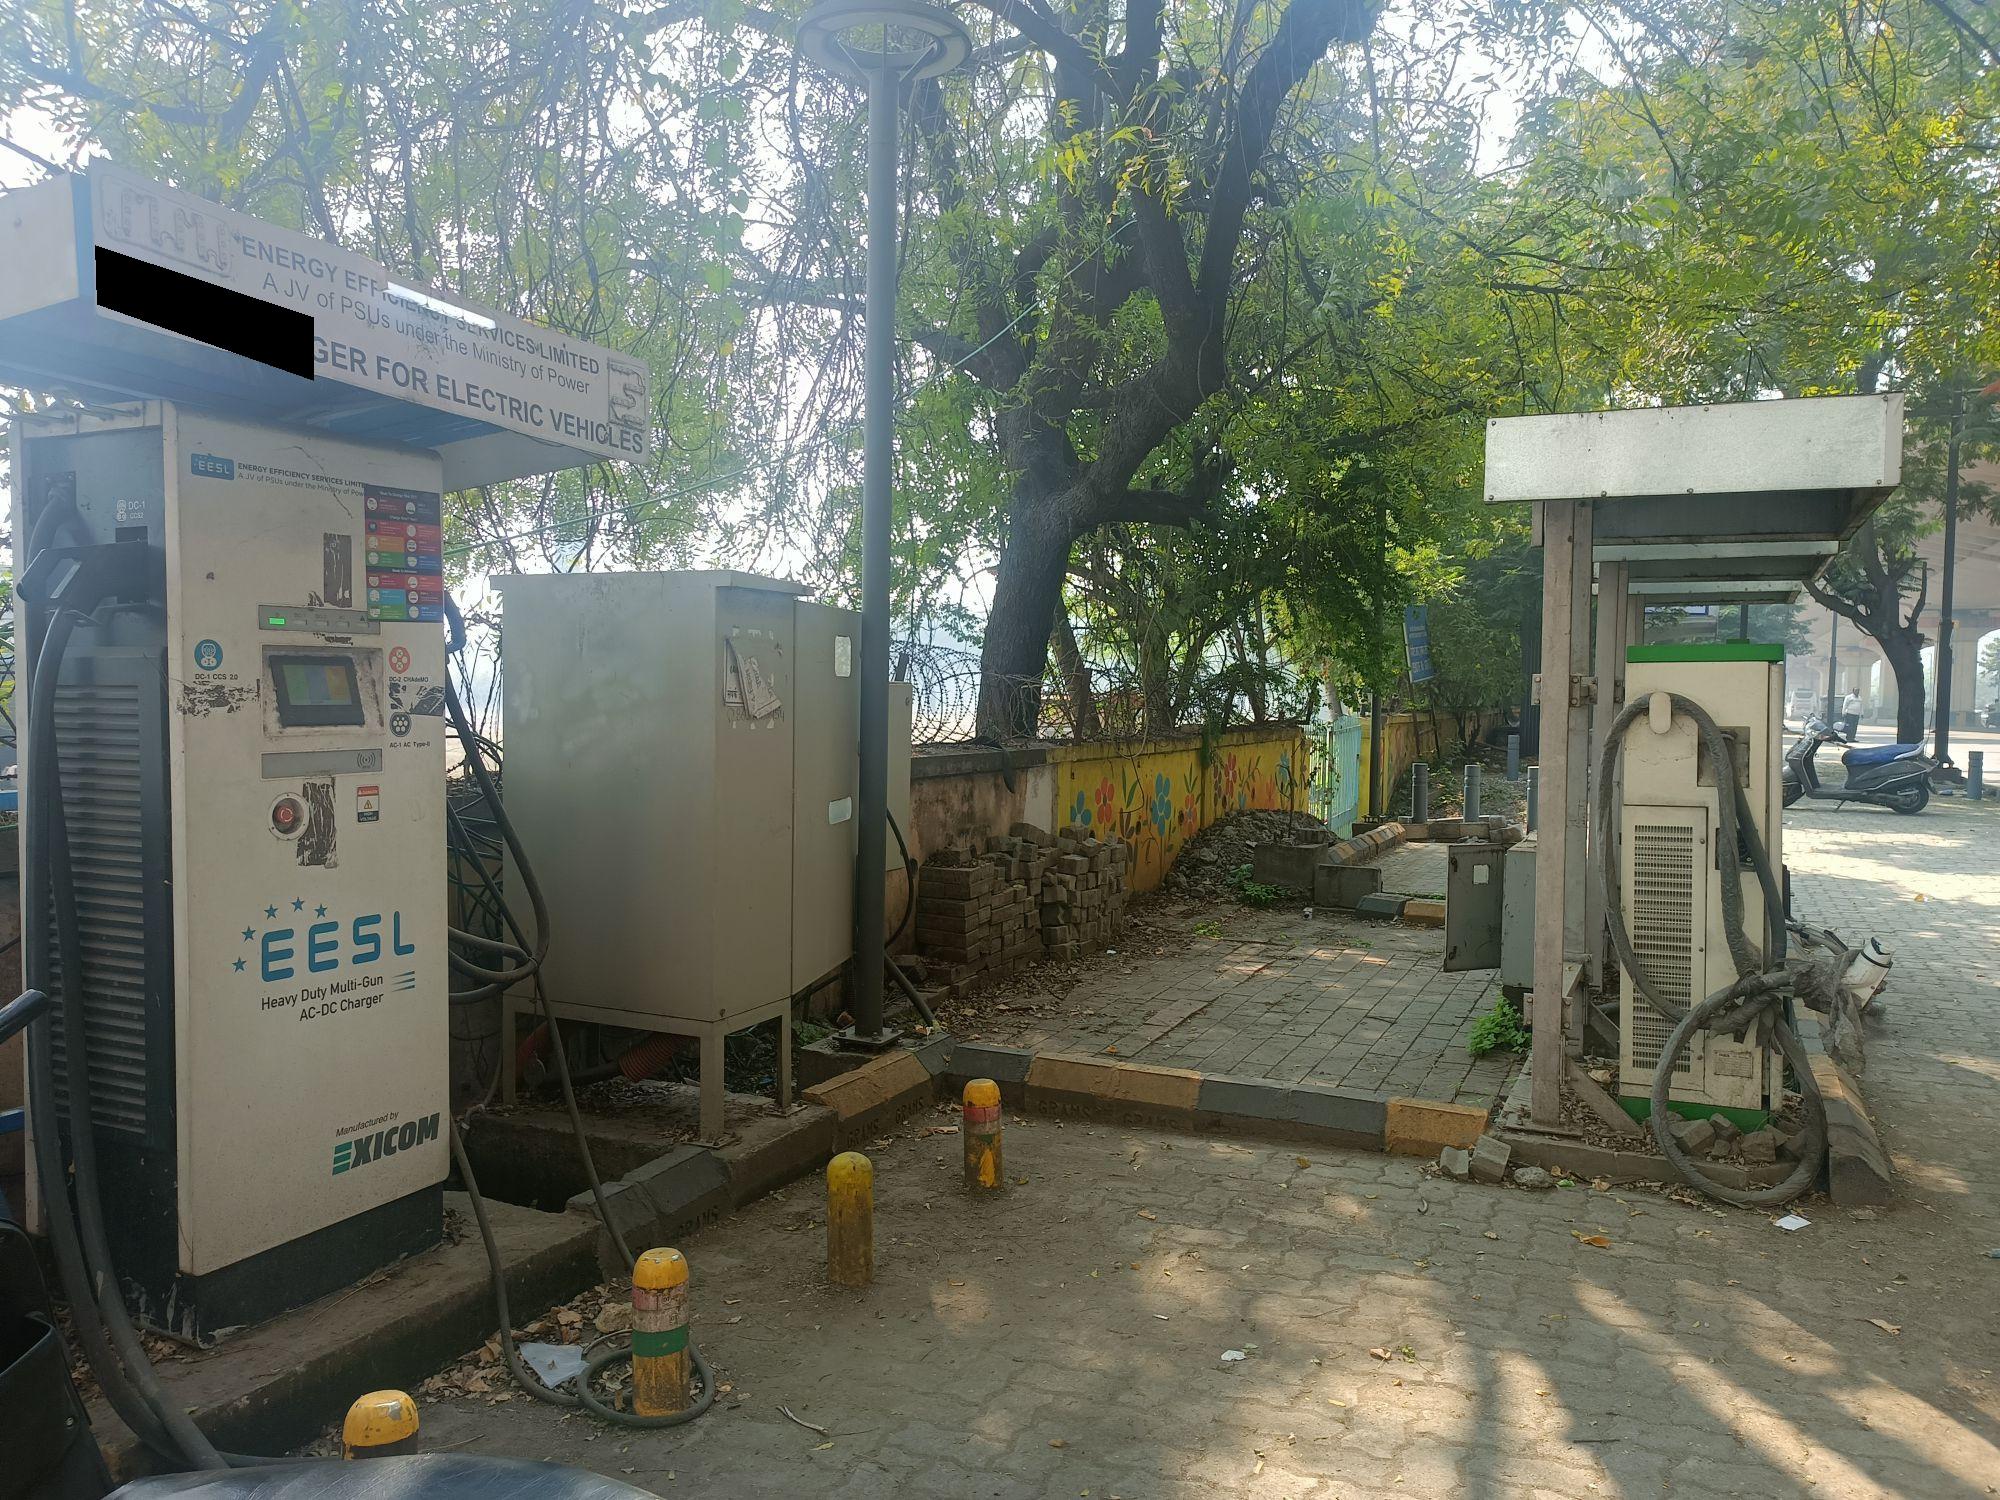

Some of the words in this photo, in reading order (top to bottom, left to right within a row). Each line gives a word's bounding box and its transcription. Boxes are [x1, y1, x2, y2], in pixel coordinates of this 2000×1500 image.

[242, 235, 338, 283] ENERGY
[540, 342, 600, 376] LIMITED
[262, 272, 279, 294] A
[284, 279, 310, 301] JV
[317, 291, 335, 310] of
[341, 296, 390, 328] PSUs
[396, 319, 440, 344] under
[444, 333, 467, 355] the
[473, 341, 526, 378] Ministry
[531, 364, 544, 380] of
[548, 367, 590, 395] Power
[376, 355, 429, 394] FOR
[437, 374, 544, 428] ELECTRIC
[549, 408, 643, 455] VEHICLES
[198, 460, 230, 475] EESL
[237, 462, 267, 474] ENERGY
[269, 467, 310, 480] EFFICIENCY
[311, 474, 344, 485] SERVICES
[344, 479, 366, 489] LIMITE
[244, 473, 255, 481] JV
[256, 474, 264, 482] of
[266, 476, 283, 485] PSUs
[284, 479, 304, 489] under
[305, 481, 316, 490] the
[128, 500, 145, 510] DC-1
[261, 911, 415, 982] EESL
[261, 993, 298, 1010] Heavy
[301, 986, 328, 1002] Duty
[330, 975, 384, 995] Multi-Gun
[299, 1002, 338, 1021] AC-DC
[340, 992, 384, 1012] Charger
[336, 1113, 389, 1137] Manufactured
[390, 1111, 399, 1121] by
[332, 1112, 440, 1176] EXICOM
